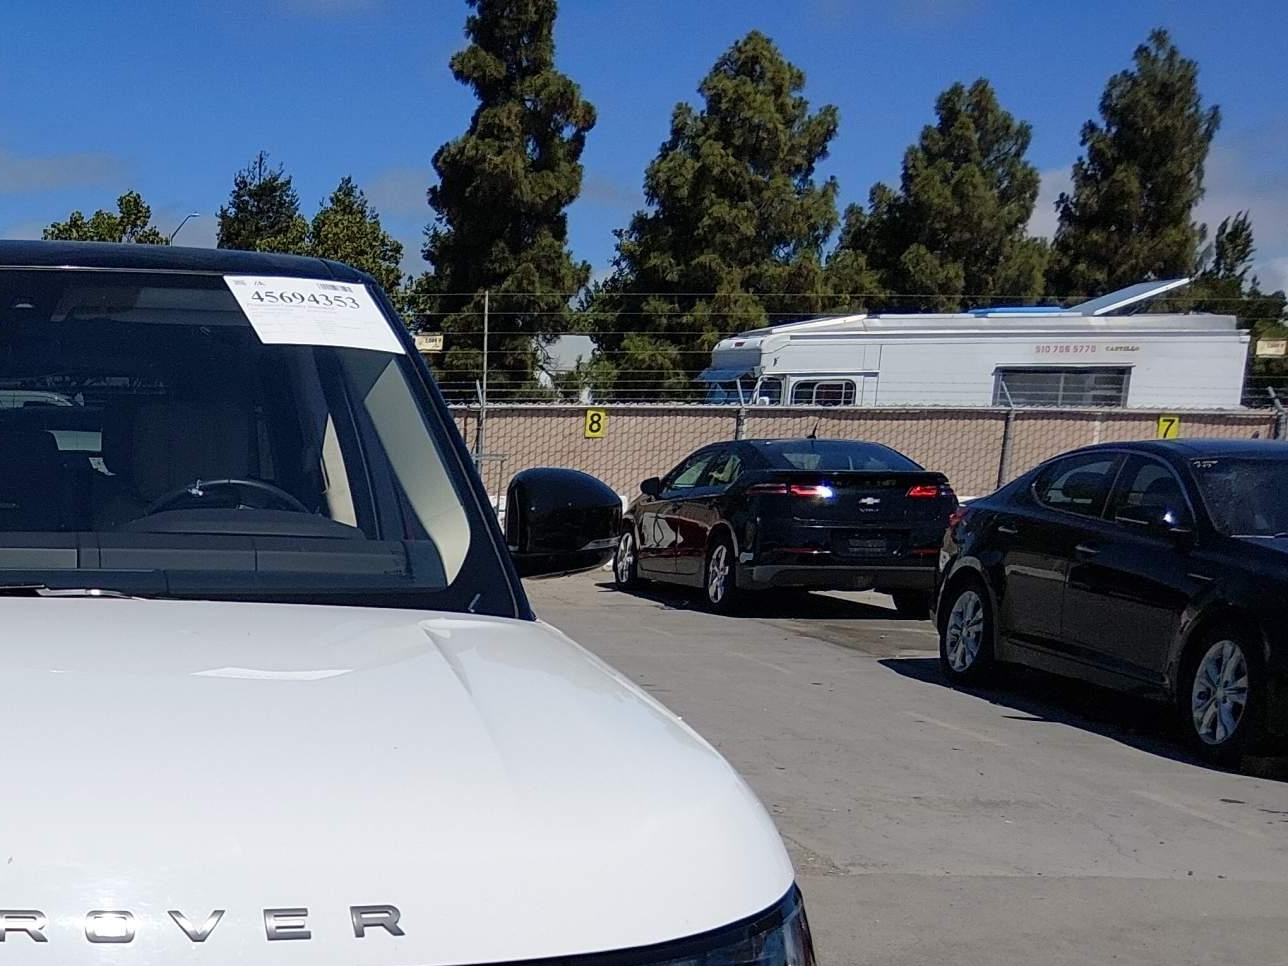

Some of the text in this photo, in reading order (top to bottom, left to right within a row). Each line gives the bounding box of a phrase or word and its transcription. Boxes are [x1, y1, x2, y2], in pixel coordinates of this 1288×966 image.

[251, 290, 361, 310] 45694353
[588, 413, 602, 433] 8
[1162, 418, 1176, 438] 7
